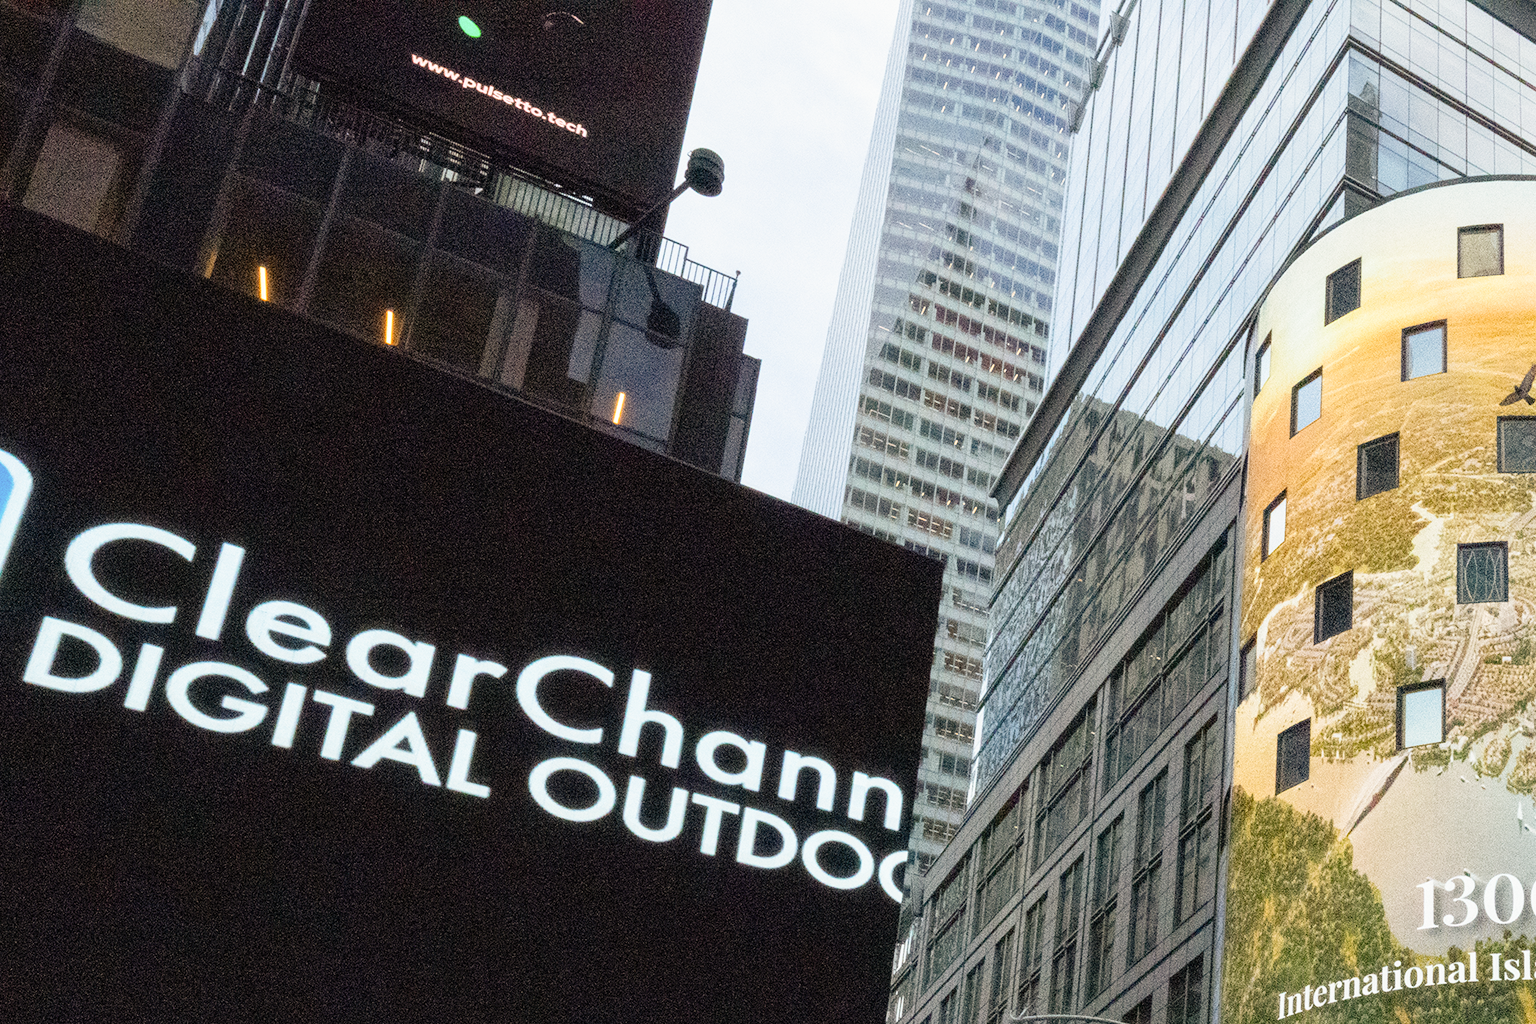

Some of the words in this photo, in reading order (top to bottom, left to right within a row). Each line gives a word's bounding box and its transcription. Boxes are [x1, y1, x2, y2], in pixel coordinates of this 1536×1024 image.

[411, 54, 587, 138] www.pulsetto.tech
[22, 616, 491, 798] DIGITAL
[1276, 952, 1479, 1020] International
